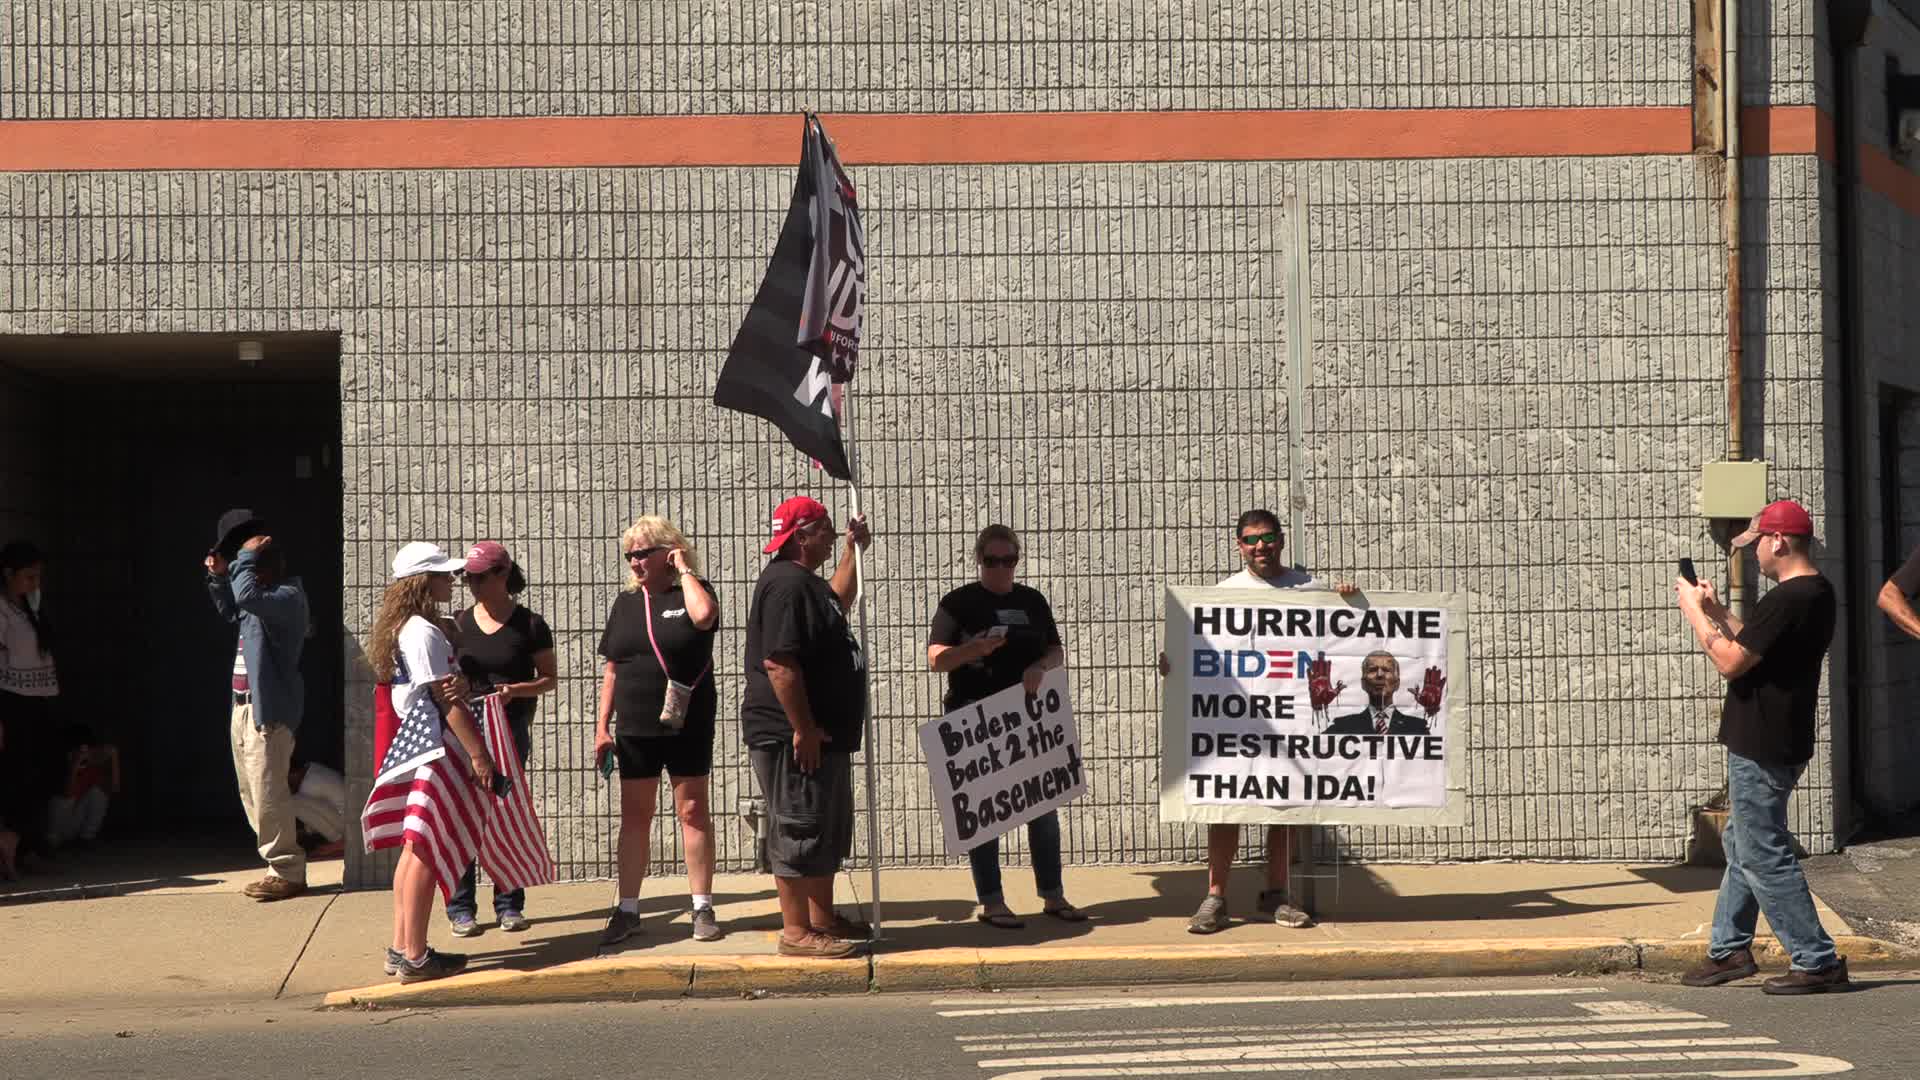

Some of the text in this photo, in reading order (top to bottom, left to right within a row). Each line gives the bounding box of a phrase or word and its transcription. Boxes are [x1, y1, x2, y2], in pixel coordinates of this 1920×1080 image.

[1193, 606, 1441, 639] HURRICANE
[1192, 694, 1295, 719] MORE
[938, 704, 1022, 757] Biden
[1005, 733, 1027, 766] 2
[1027, 721, 1065, 759] the
[1191, 732, 1444, 760] DESTRUCTIVE
[952, 743, 1082, 841] Basement
[1189, 774, 1376, 801] THAN IDA!
